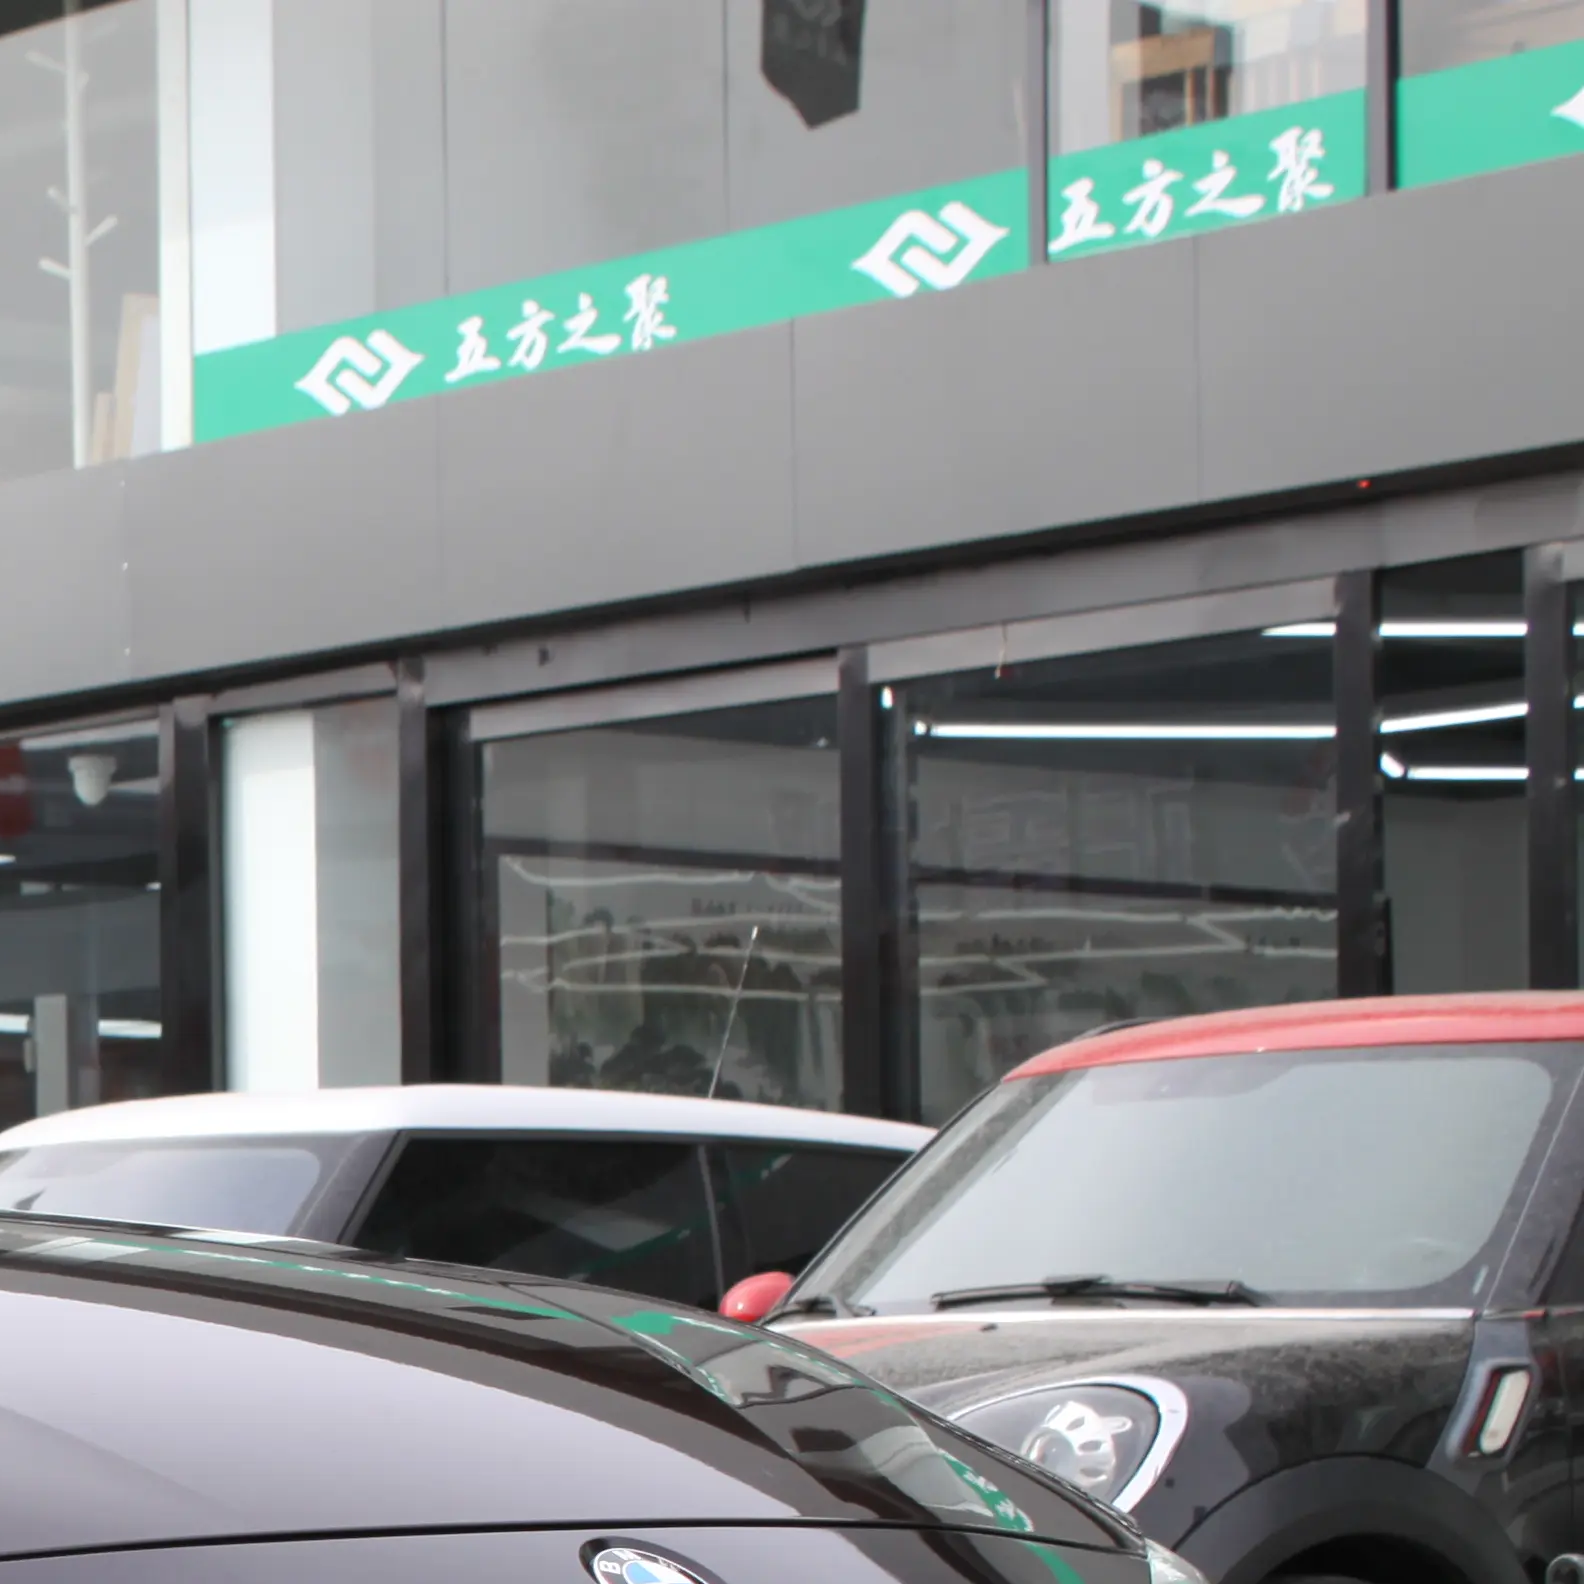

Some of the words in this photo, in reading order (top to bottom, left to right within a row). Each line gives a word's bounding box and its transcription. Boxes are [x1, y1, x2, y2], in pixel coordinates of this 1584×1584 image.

[1046, 125, 1335, 255] 五方之聚
[443, 272, 679, 384] 五方之聚
